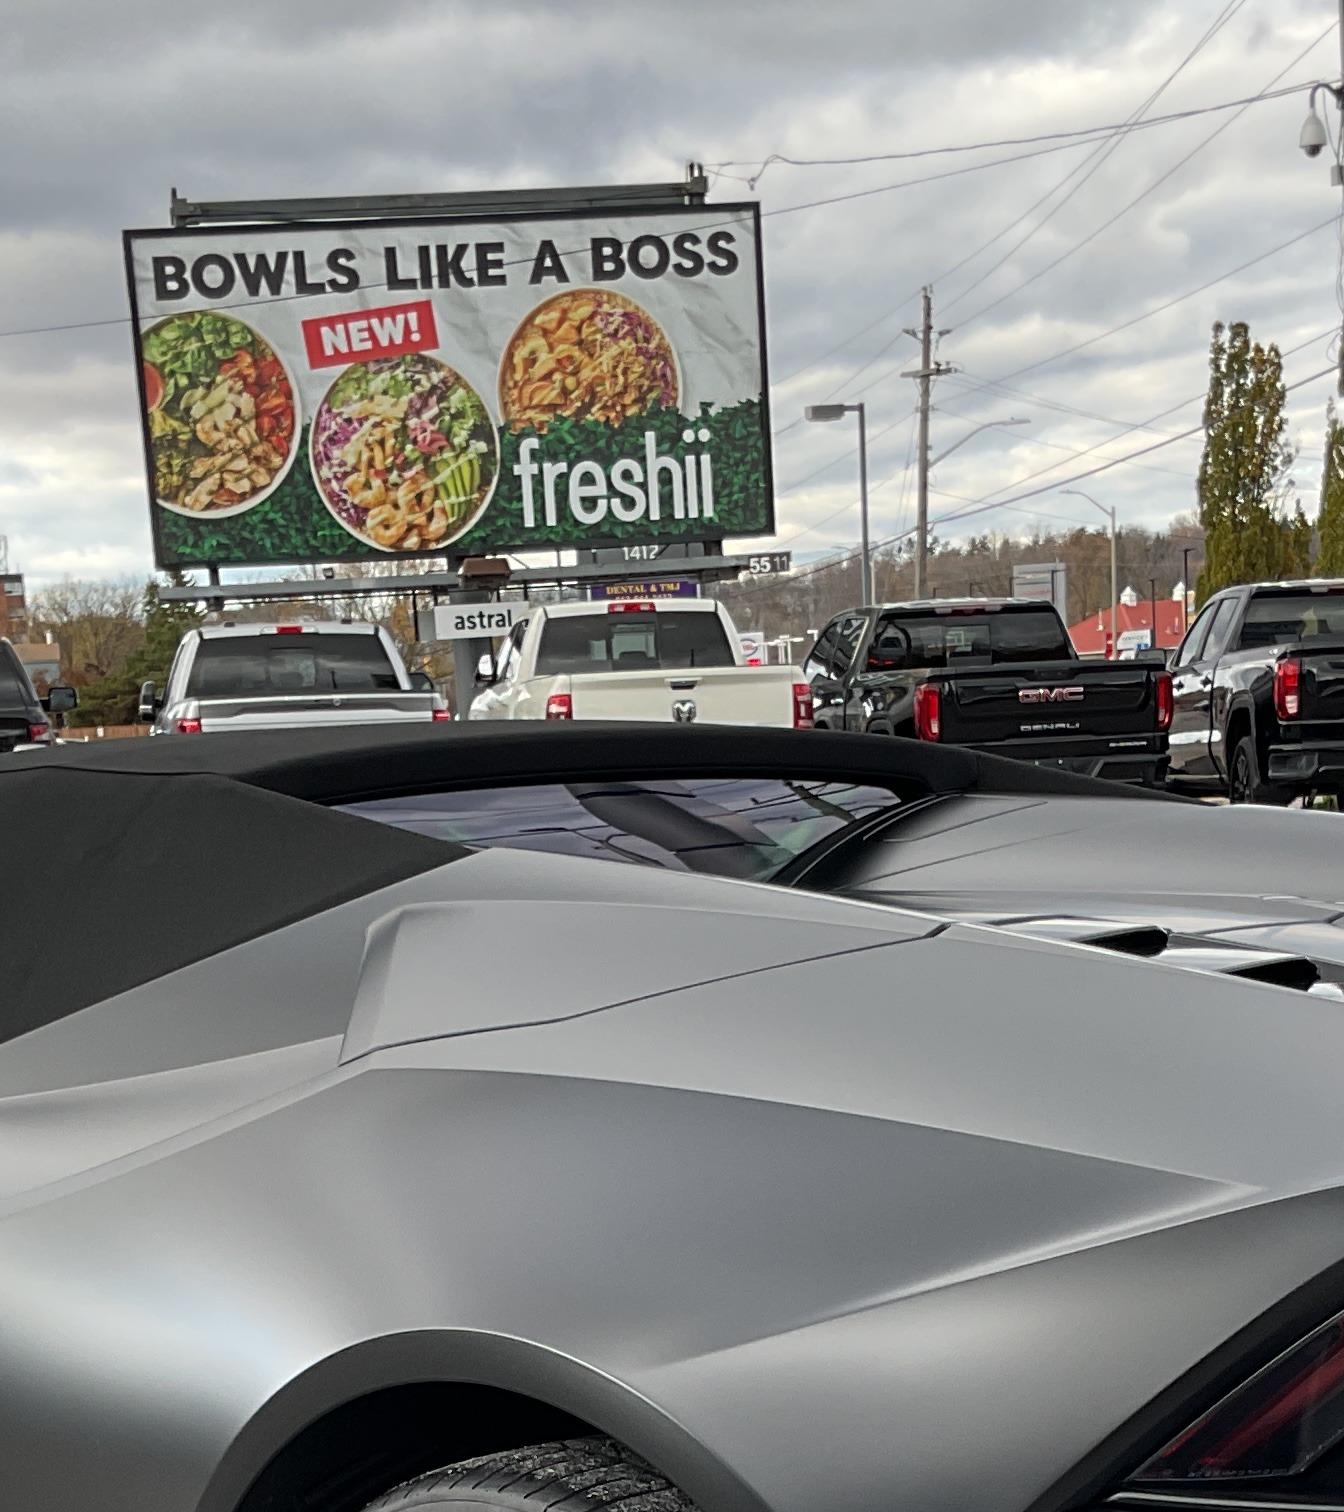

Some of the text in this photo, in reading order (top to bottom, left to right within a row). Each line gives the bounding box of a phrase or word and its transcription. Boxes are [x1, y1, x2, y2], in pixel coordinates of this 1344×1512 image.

[152, 231, 739, 301] BOWLS LIKE A BOSS
[320, 311, 422, 357] NEW!
[513, 428, 714, 528] freshii
[606, 584, 646, 595] DENTAL
[454, 609, 512, 630] astral
[1018, 686, 1085, 704] GMC
